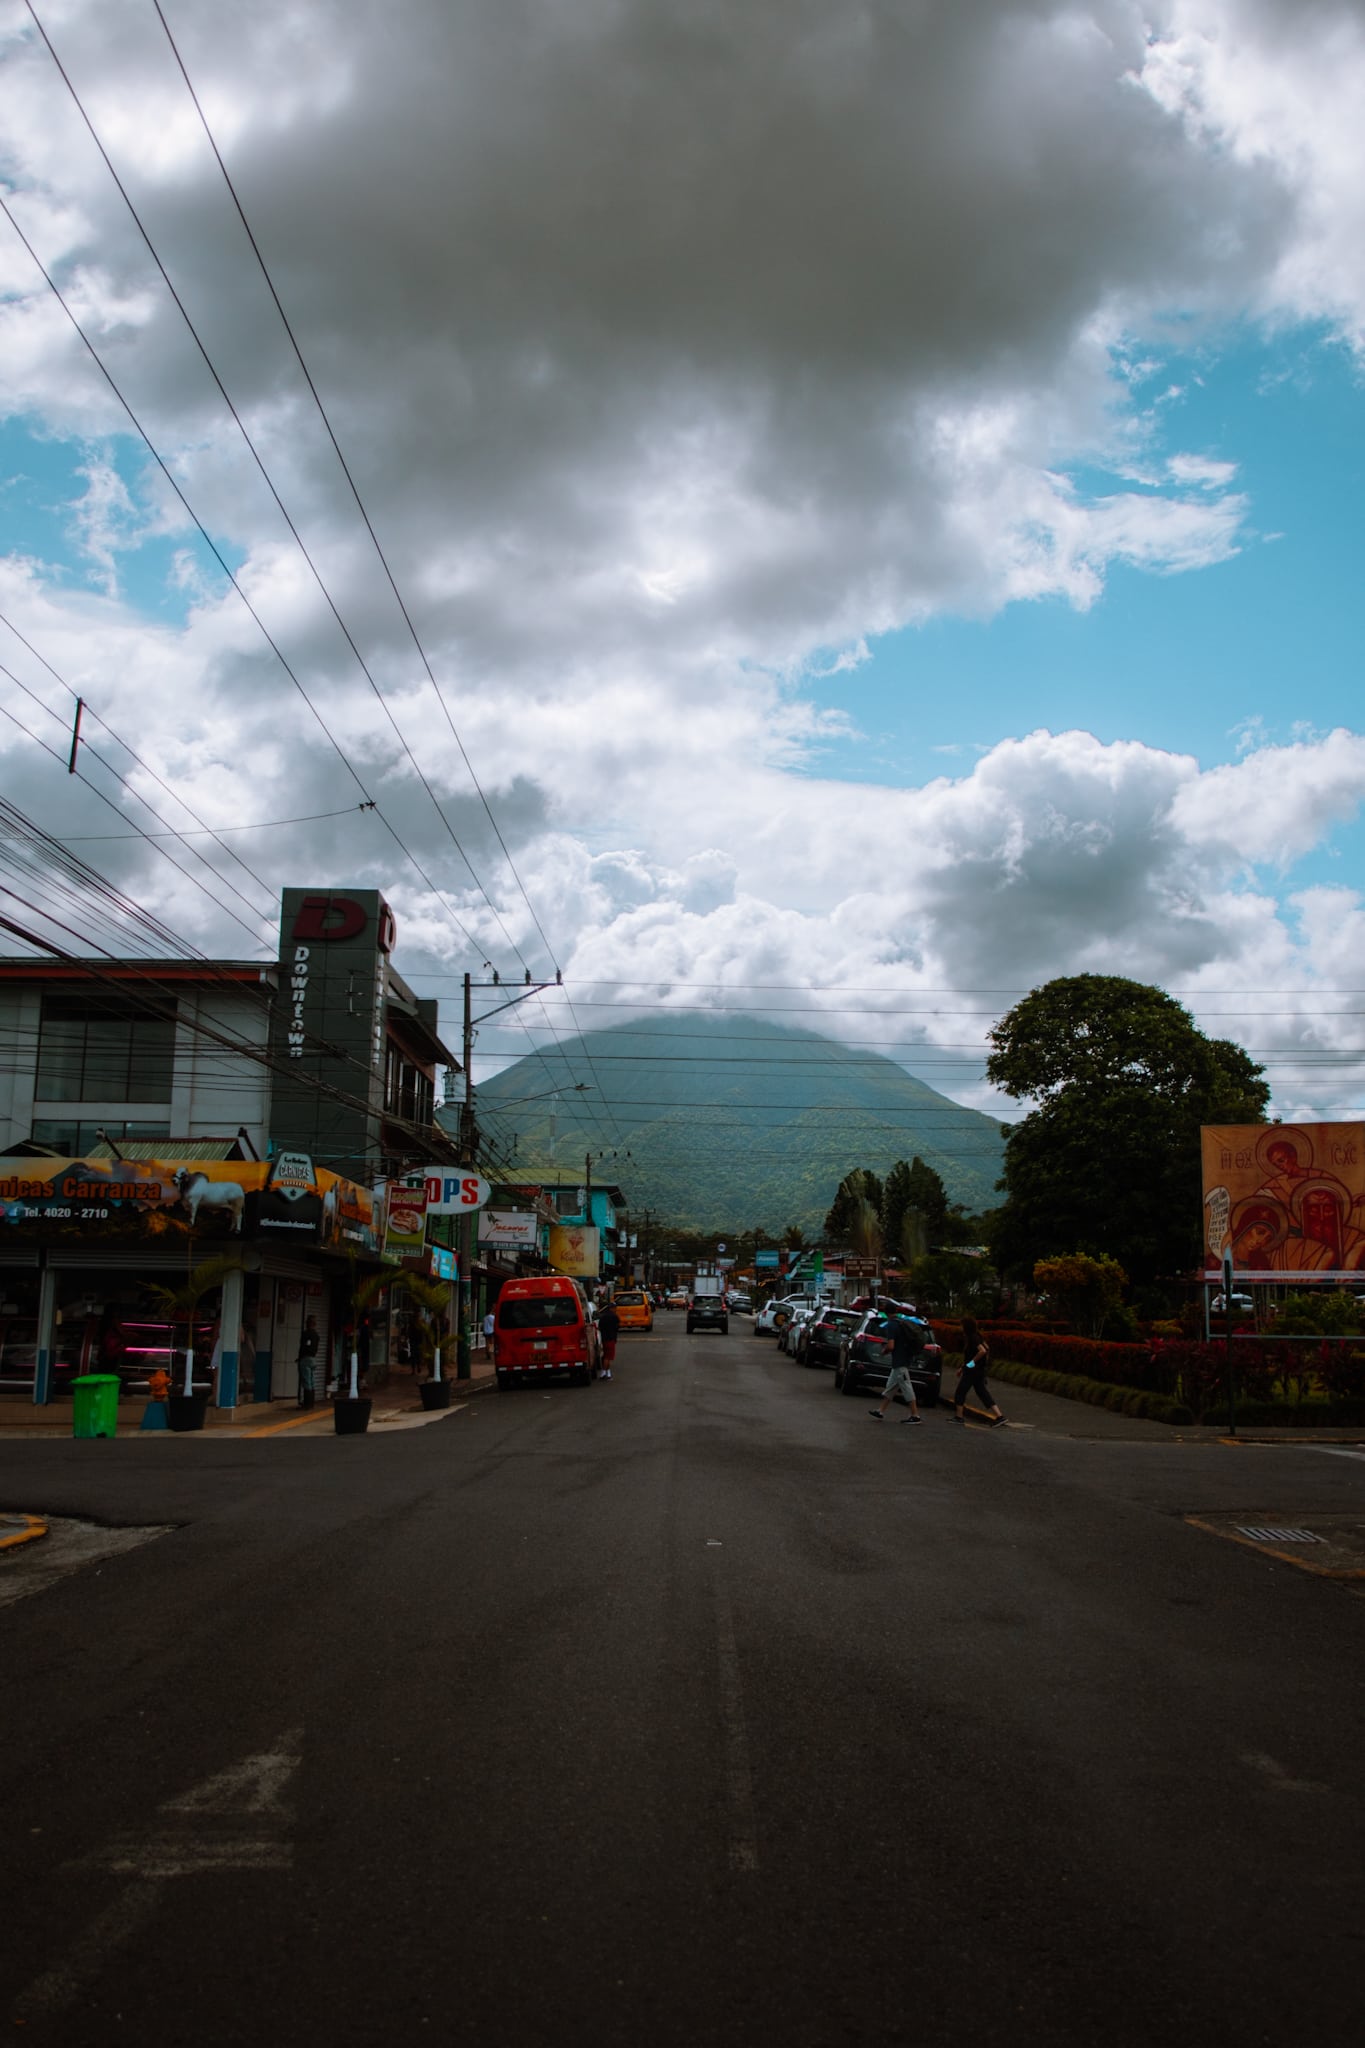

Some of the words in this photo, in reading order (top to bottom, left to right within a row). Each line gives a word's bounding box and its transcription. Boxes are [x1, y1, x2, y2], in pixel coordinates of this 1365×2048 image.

[288, 946, 310, 1058] Downtown
[279, 1165, 310, 1180] CARNICAS
[62, 1177, 161, 1200] Carranza
[24, 1207, 42, 1217] Tel.
[44, 1207, 71, 1218] 4020
[81, 1208, 108, 1219] 2710
